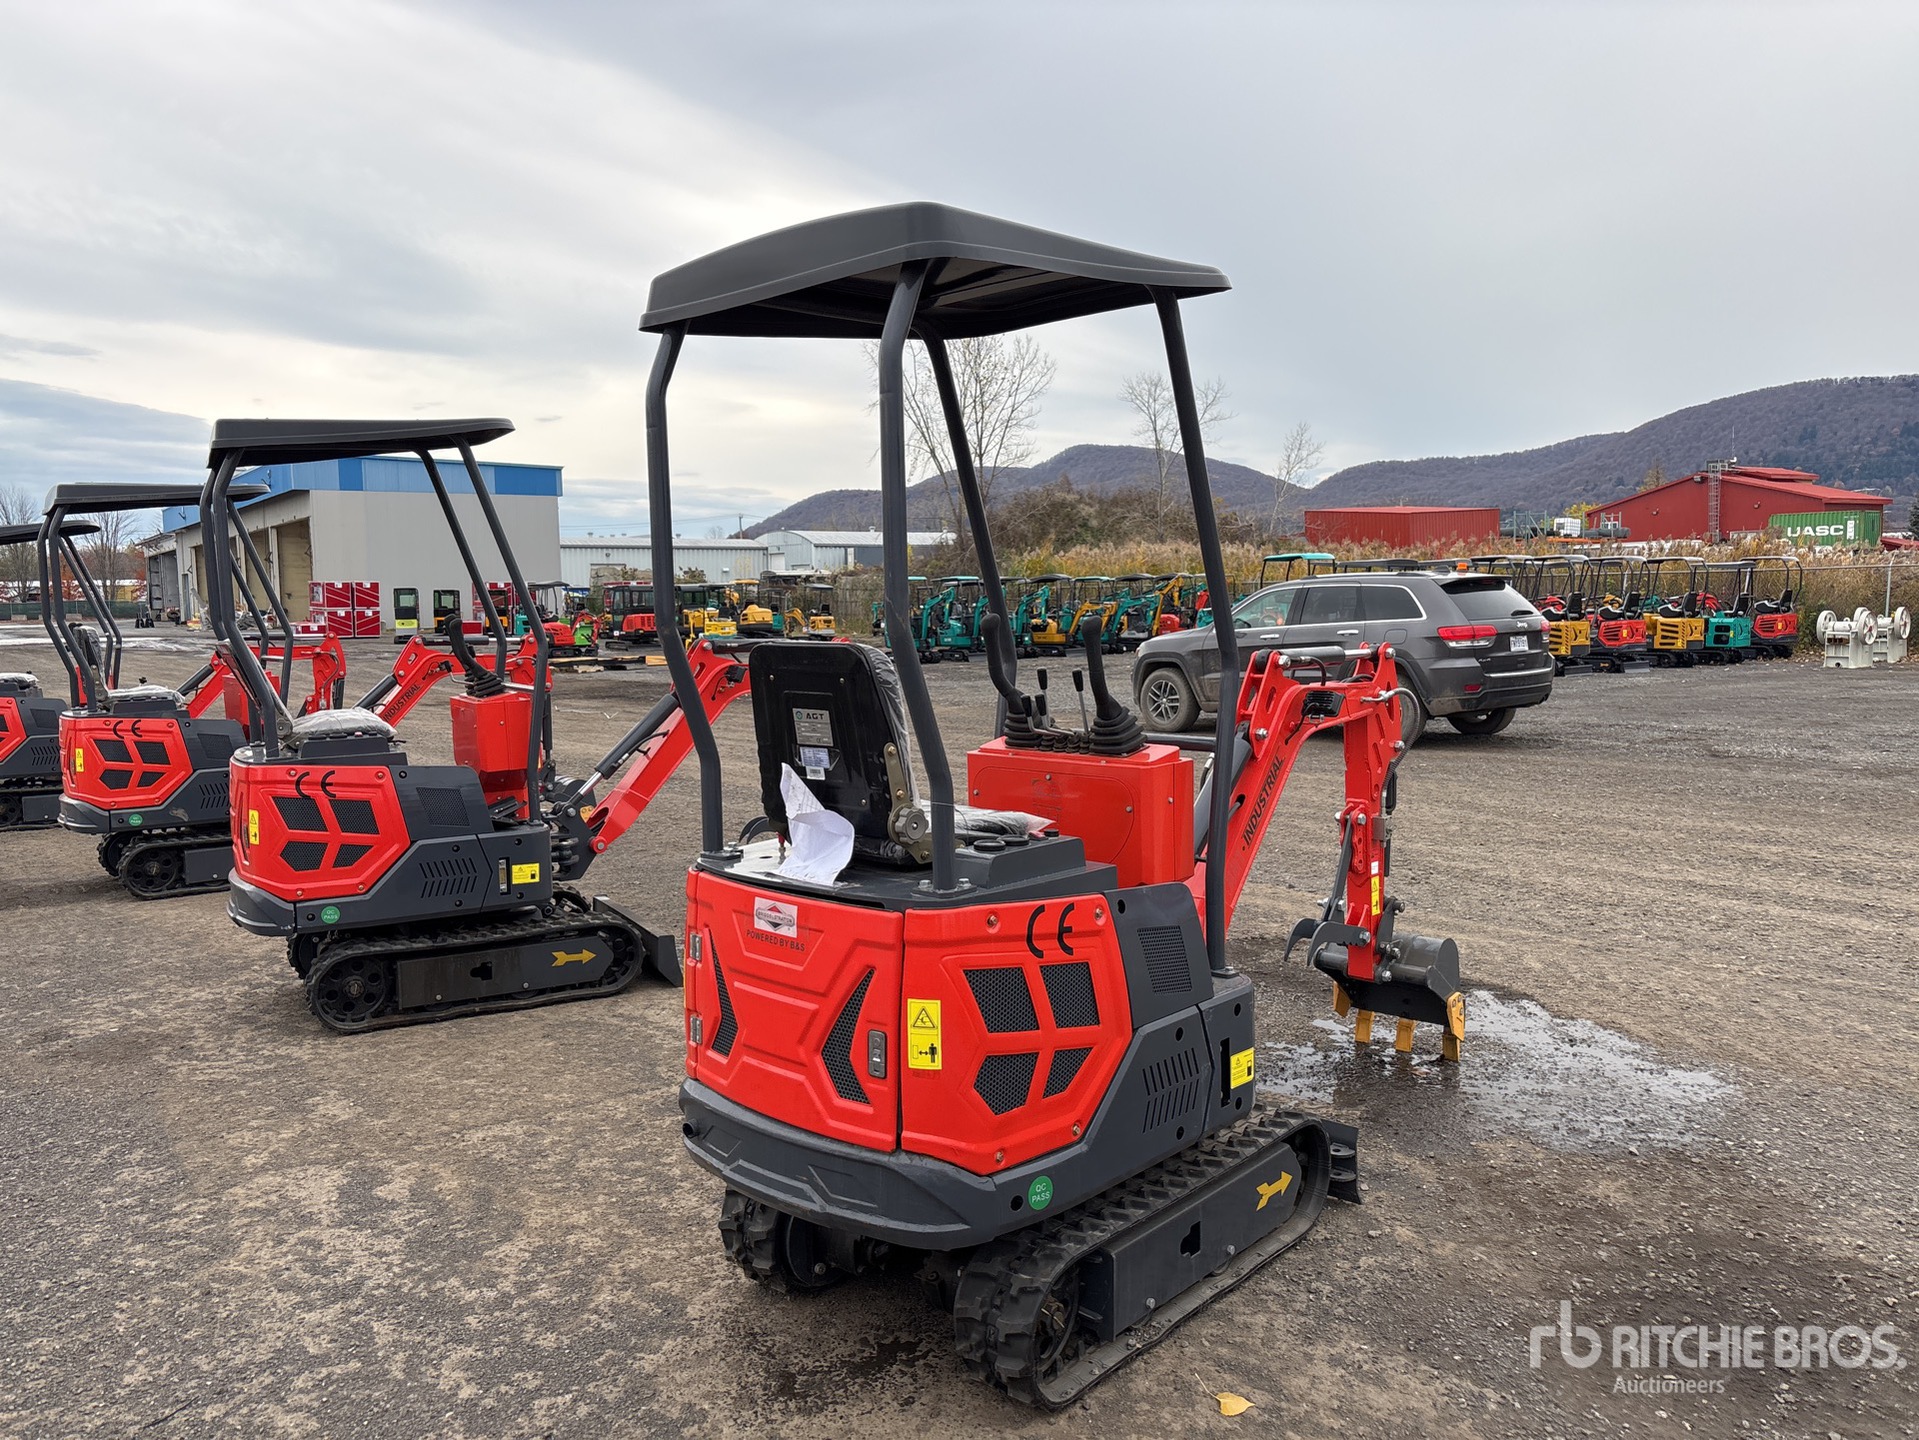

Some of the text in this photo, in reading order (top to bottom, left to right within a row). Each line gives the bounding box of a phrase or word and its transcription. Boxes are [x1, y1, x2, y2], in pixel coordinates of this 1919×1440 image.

[1787, 525, 1844, 537] UASC
[1241, 755, 1286, 847] INDUSTRIAL
[746, 929, 806, 952] POWERED BY B&S
[1035, 1182, 1047, 1192] QC
[1031, 1191, 1050, 1203] PASS
